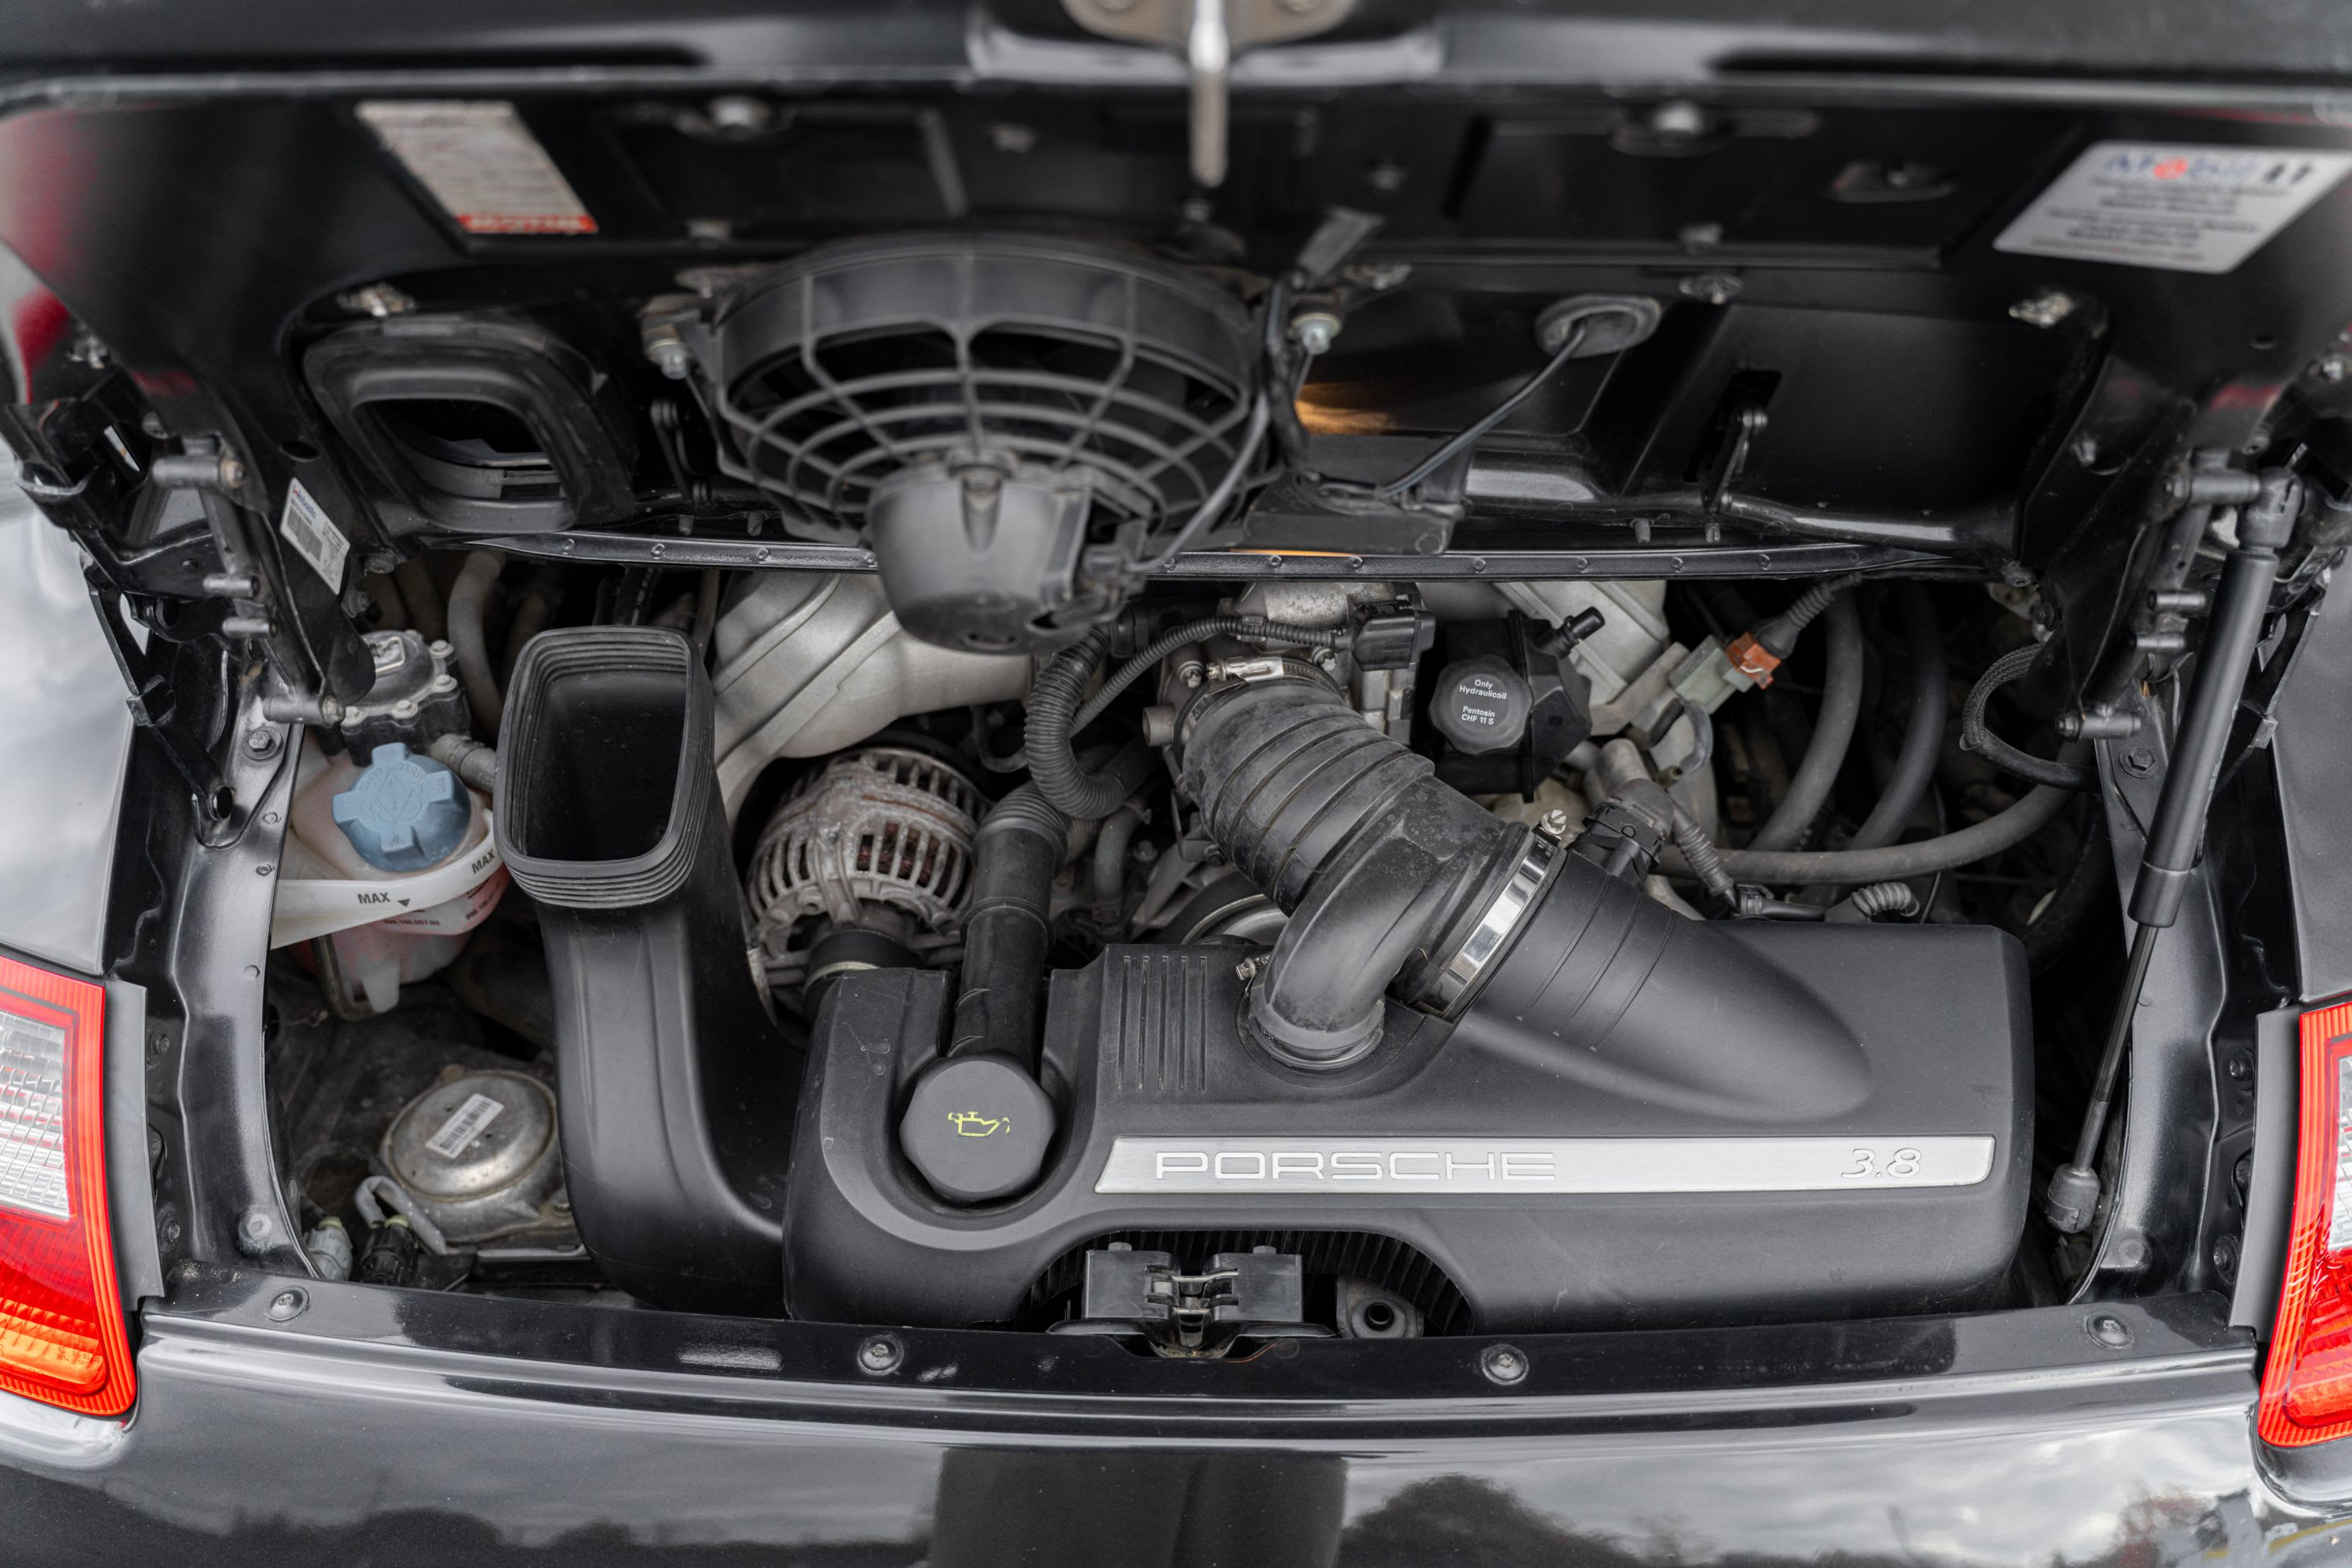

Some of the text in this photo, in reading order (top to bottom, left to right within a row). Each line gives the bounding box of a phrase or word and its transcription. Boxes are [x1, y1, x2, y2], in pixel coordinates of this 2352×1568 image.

[1475, 679, 1493, 689] Only
[1459, 685, 1507, 699] Hydraulicoil
[1463, 706, 1495, 717] Pentosin
[471, 849, 495, 874] MAX
[358, 892, 390, 904] MAX
[1156, 1150, 1556, 1181] PORSCHE
[1841, 1148, 1922, 1179] 3.8
